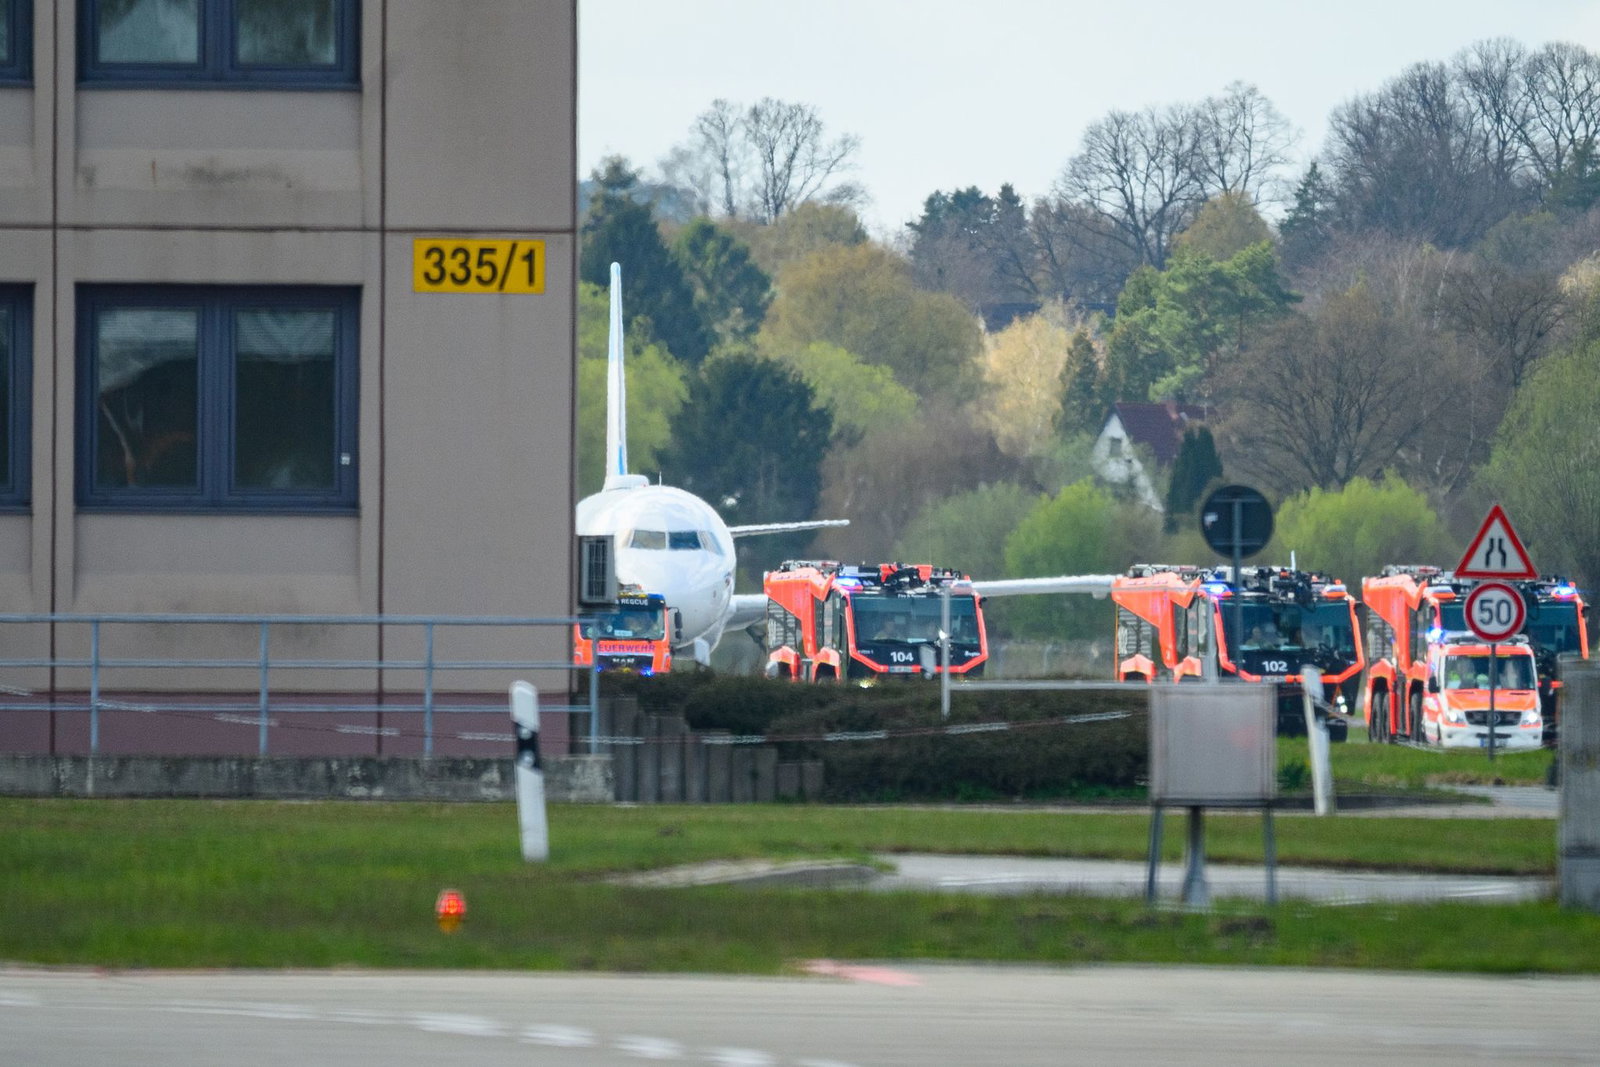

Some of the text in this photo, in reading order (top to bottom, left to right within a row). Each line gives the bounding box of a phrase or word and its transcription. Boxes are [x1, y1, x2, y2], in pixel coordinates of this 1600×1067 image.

[423, 242, 536, 292] 335/1
[1478, 599, 1512, 626] 50
[597, 644, 655, 652] EUERWEHR
[890, 651, 914, 662] 104
[1262, 661, 1288, 672] 102
